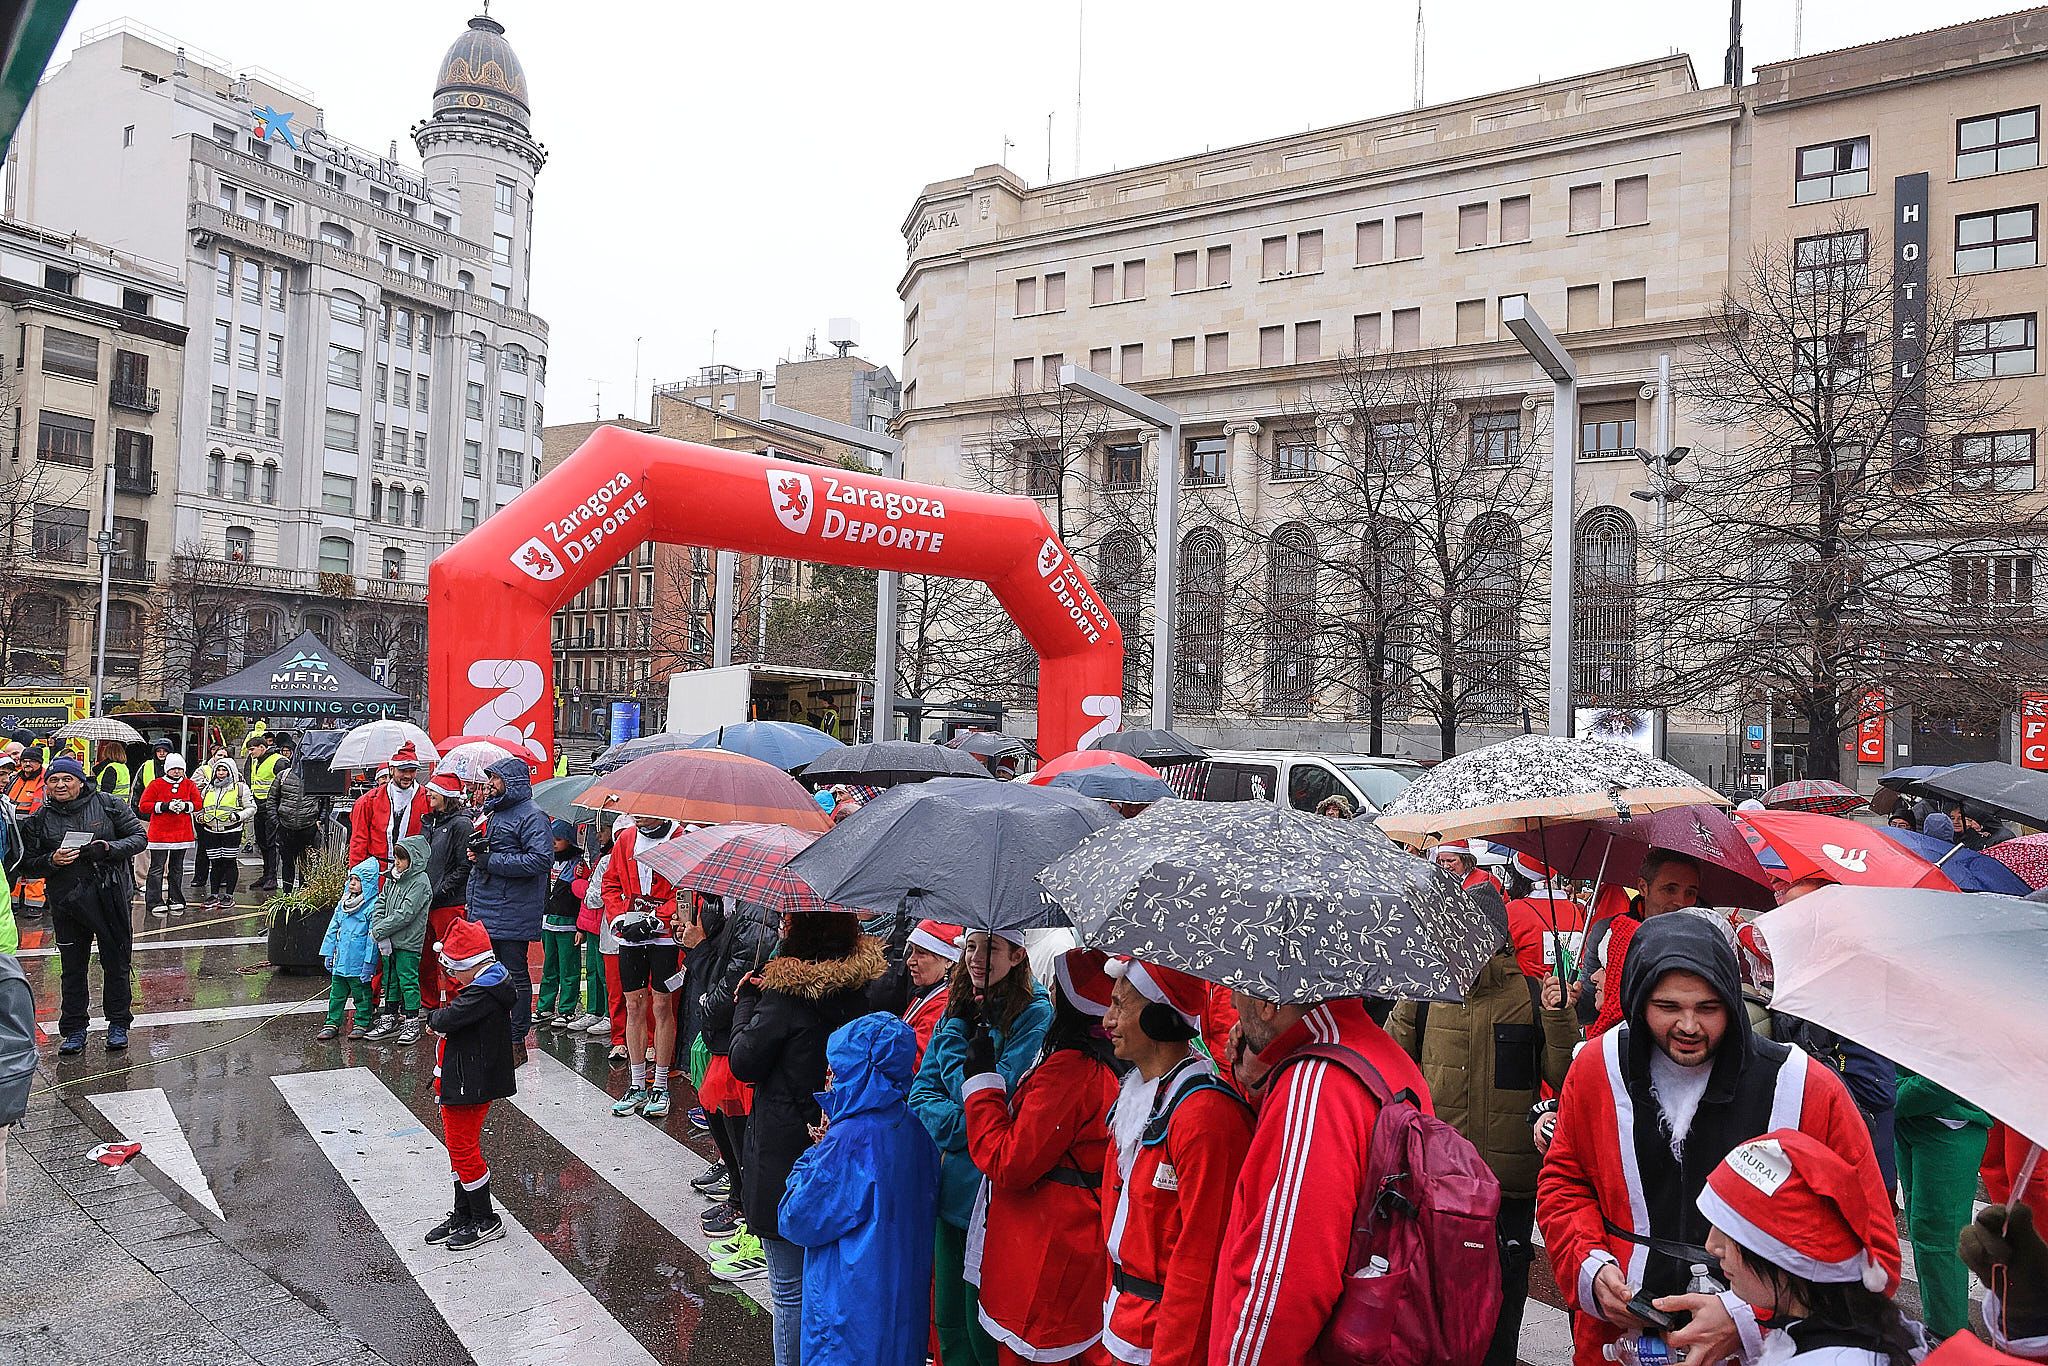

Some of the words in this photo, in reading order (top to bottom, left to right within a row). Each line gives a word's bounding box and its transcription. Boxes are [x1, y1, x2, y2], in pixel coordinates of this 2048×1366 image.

[302, 127, 433, 203] CaixaBank
[1901, 203, 1920, 379] HOTEL
[544, 472, 633, 544] Zaragoza
[823, 477, 946, 520] Zaragoza
[563, 491, 648, 565] DEPORTE
[821, 508, 945, 553] DEPORTE
[1048, 575, 1101, 644] DEPORTE
[1062, 564, 1109, 631] Zaragoza
[0, 697, 66, 705] AMBULANCIA
[270, 671, 339, 685] META
[270, 683, 340, 692] RUNNING
[199, 697, 398, 715] METARUNNING.COM
[2023, 700, 2048, 762] KFC
[1740, 1150, 1779, 1183] RURAL
